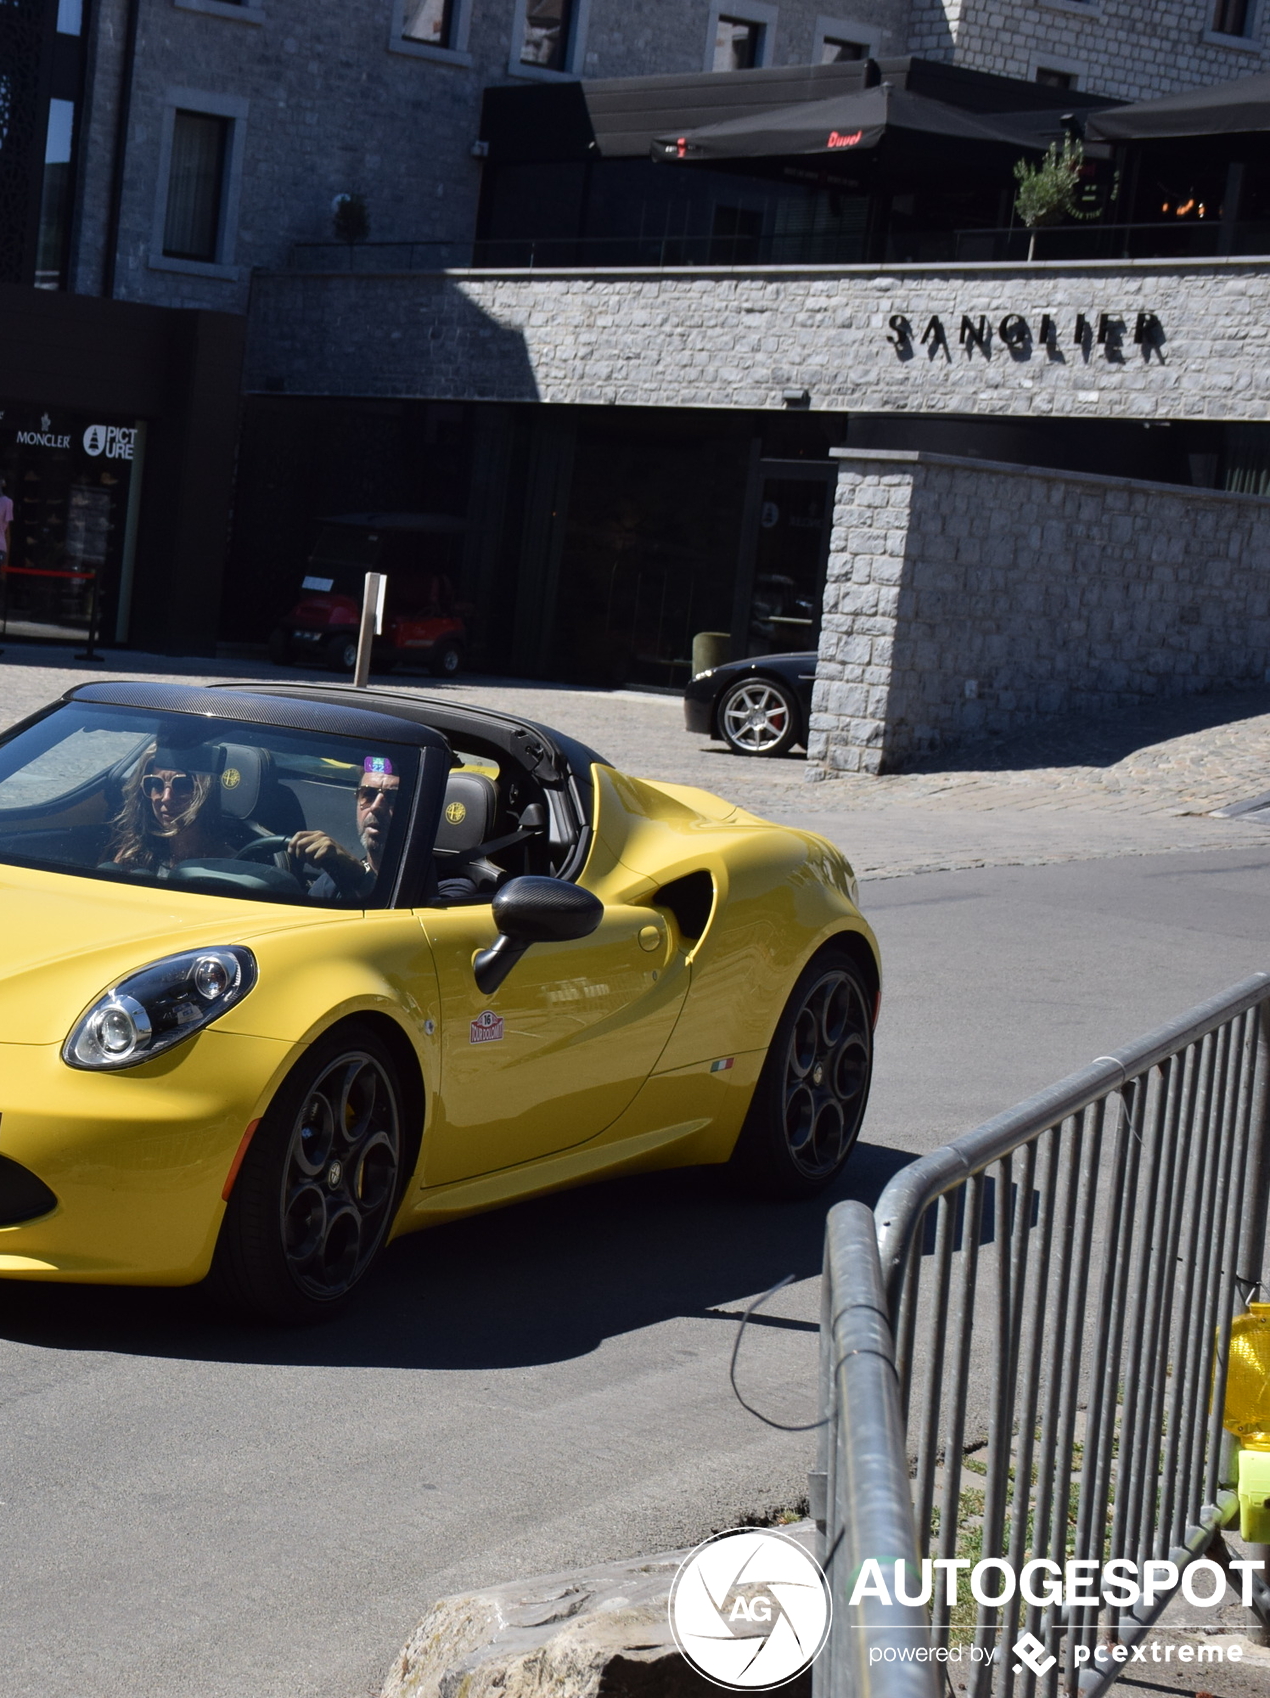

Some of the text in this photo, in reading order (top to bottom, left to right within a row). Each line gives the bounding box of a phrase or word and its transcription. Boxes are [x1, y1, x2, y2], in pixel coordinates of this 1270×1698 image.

[827, 130, 862, 148] Duvel
[16, 431, 70, 448] MONCLER
[107, 426, 138, 443] PICT
[105, 443, 134, 460] URE
[484, 1014, 492, 1025] 16
